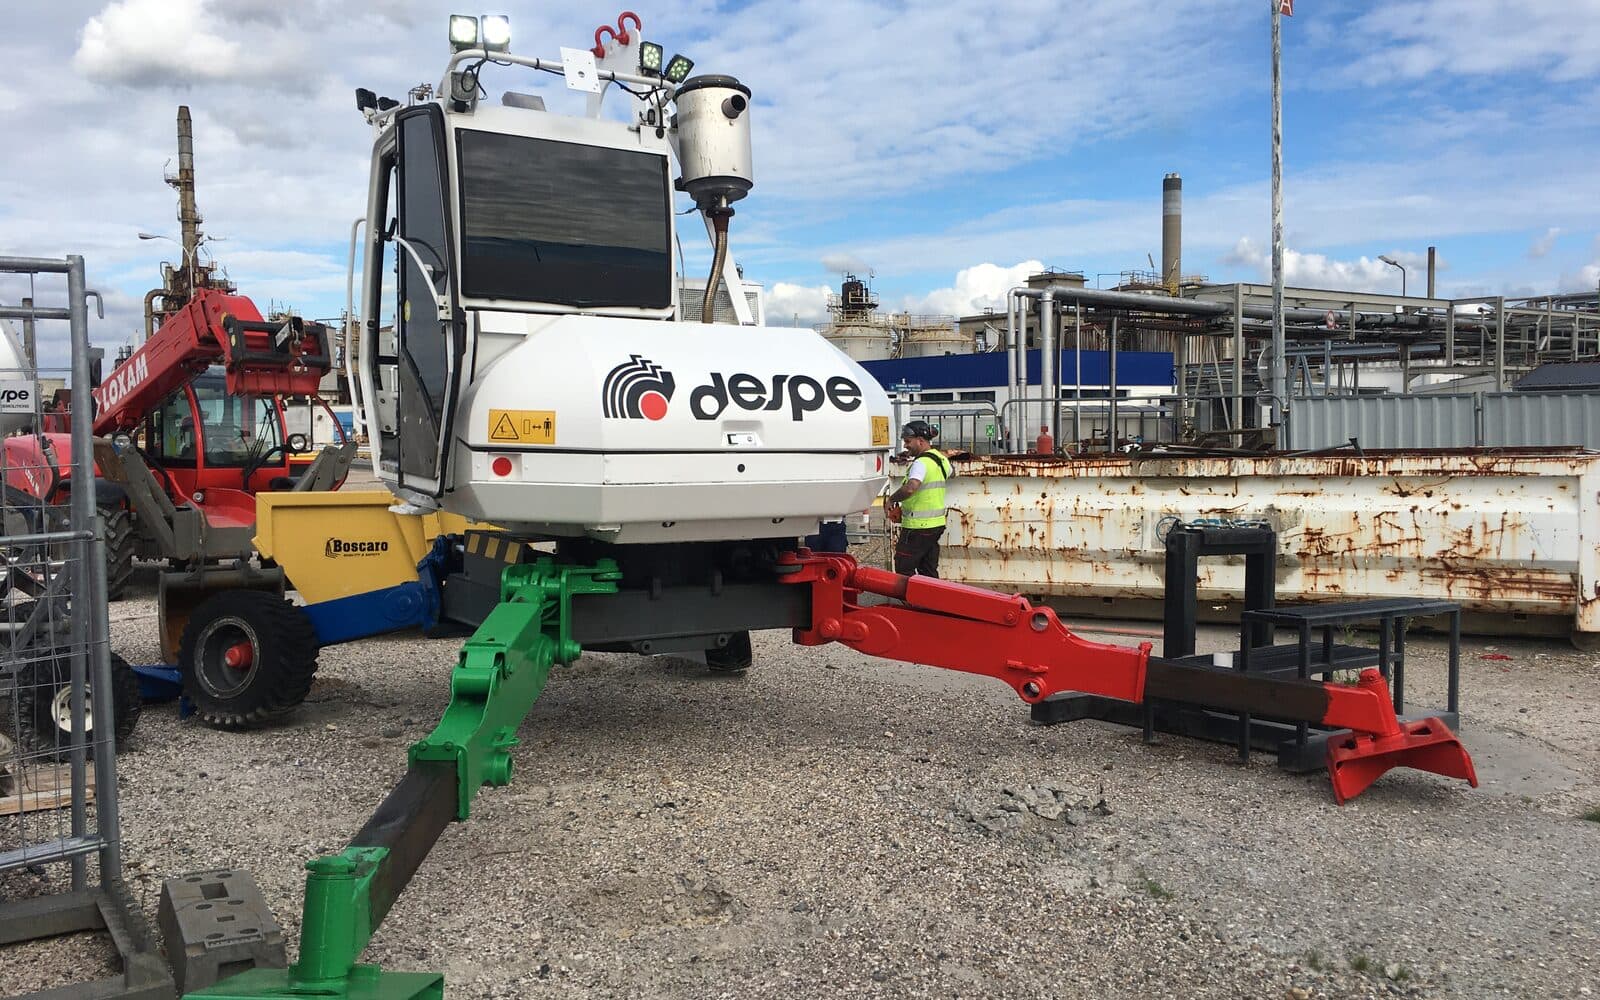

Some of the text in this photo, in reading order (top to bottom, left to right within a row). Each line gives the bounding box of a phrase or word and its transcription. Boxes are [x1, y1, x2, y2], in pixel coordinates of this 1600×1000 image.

[102, 352, 149, 413] LOXAM
[690, 372, 862, 422] despe
[333, 539, 388, 553] Boscaro
